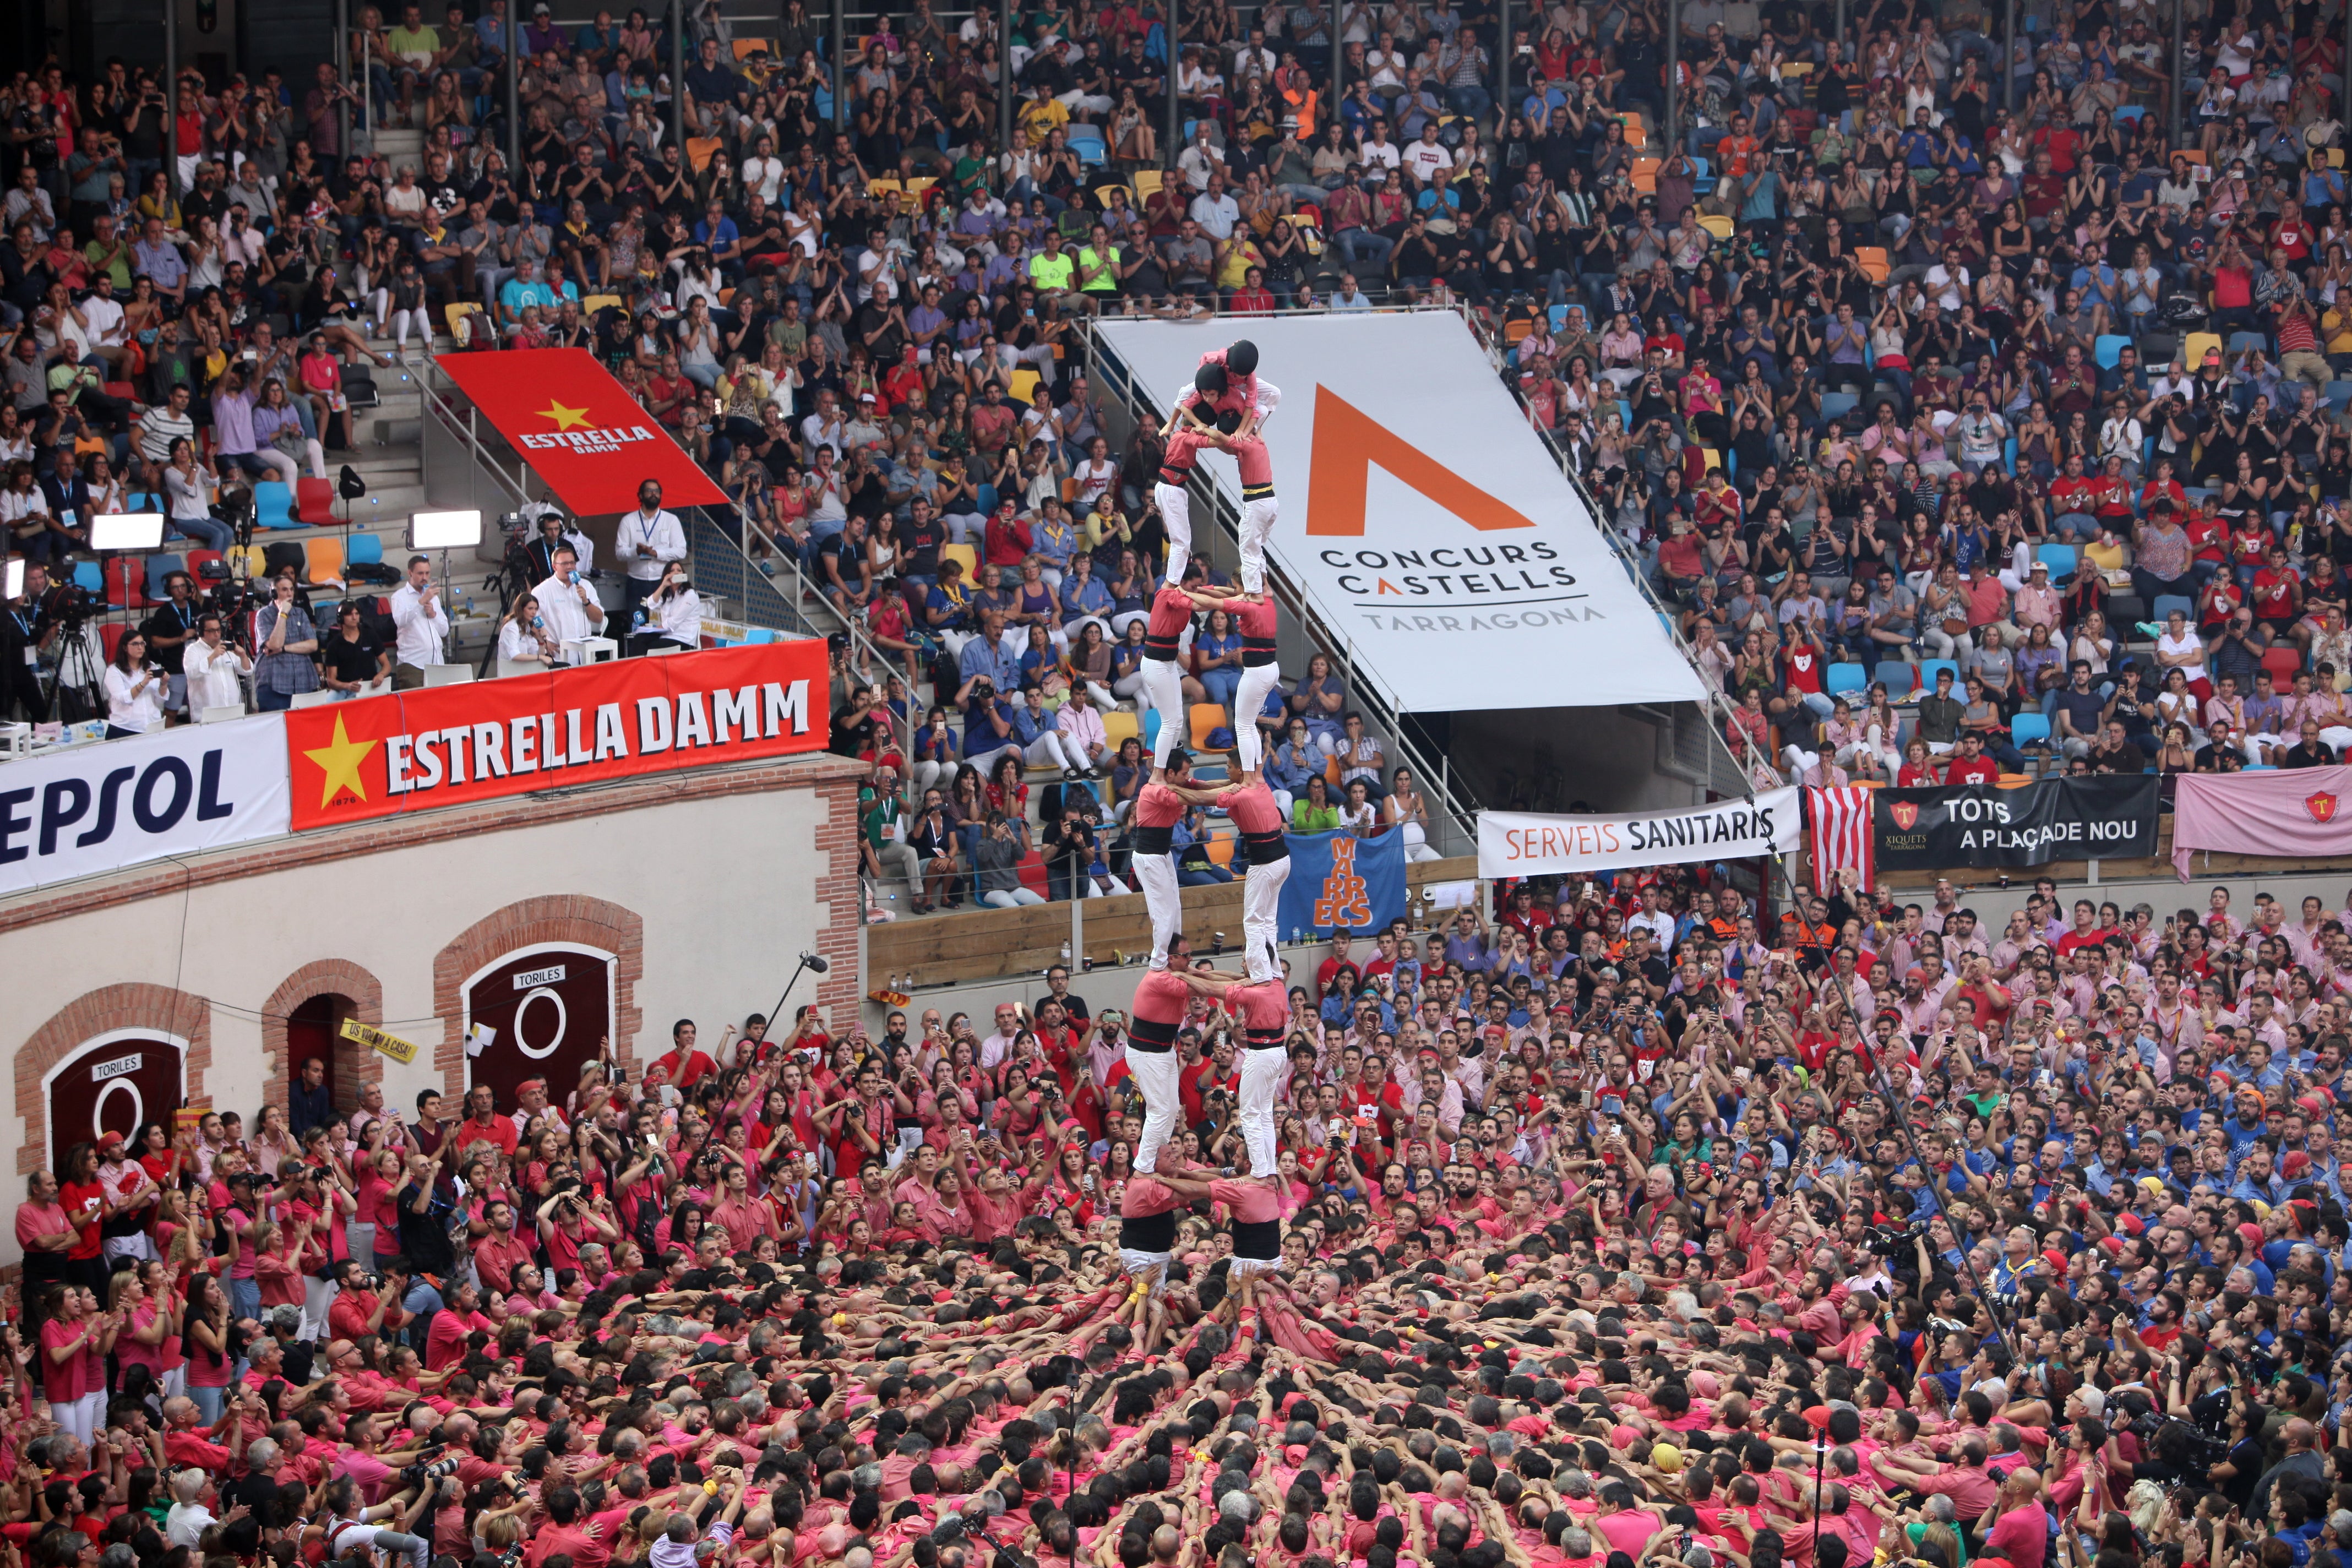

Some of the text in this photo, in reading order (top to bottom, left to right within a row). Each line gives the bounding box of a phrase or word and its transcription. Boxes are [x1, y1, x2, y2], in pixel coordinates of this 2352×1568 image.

[518, 426, 656, 449] ESTRELLA
[573, 443, 622, 454] DAMM
[1320, 542, 1558, 569] CONCURS
[1338, 567, 1576, 595] CASTELLS
[1362, 606, 1607, 631] TARRAGONA
[385, 679, 810, 796] ESTRELLA DAMM
[332, 796, 356, 807] 1876
[1943, 798, 2011, 824] TOTS
[1506, 807, 1774, 860] SERVEIS SANITARIS
[1886, 835, 1926, 845] XIQUETS
[1960, 830, 1977, 848] A
[2089, 820, 2137, 841] NOU
[519, 968, 560, 986] TORILES
[349, 1023, 412, 1056] US VOLM A CASA!
[97, 1057, 137, 1077] TORILES
